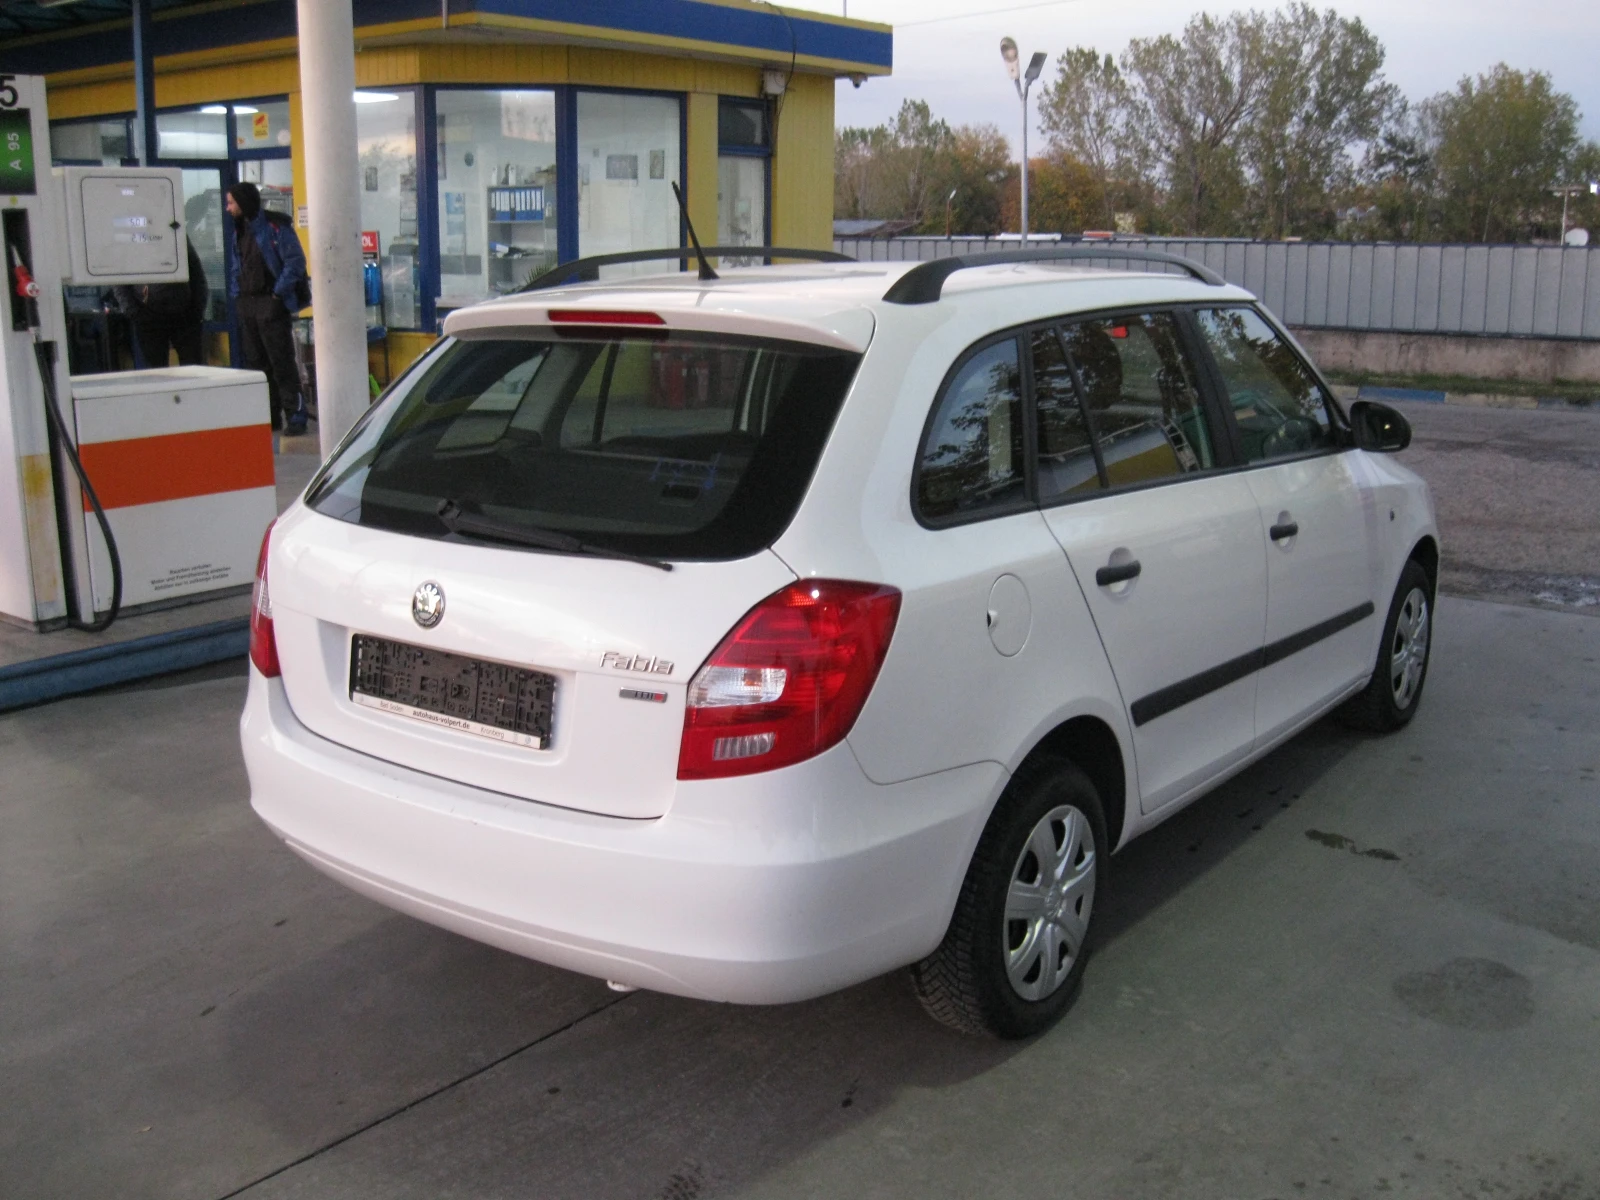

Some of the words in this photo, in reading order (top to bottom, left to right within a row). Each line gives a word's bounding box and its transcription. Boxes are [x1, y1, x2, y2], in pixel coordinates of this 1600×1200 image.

[7, 132, 20, 151] 95
[9, 159, 22, 171] A
[599, 651, 675, 675] Fabia
[412, 709, 471, 729] autohaus-volpert.de
[480, 726, 505, 739] Kronberg
